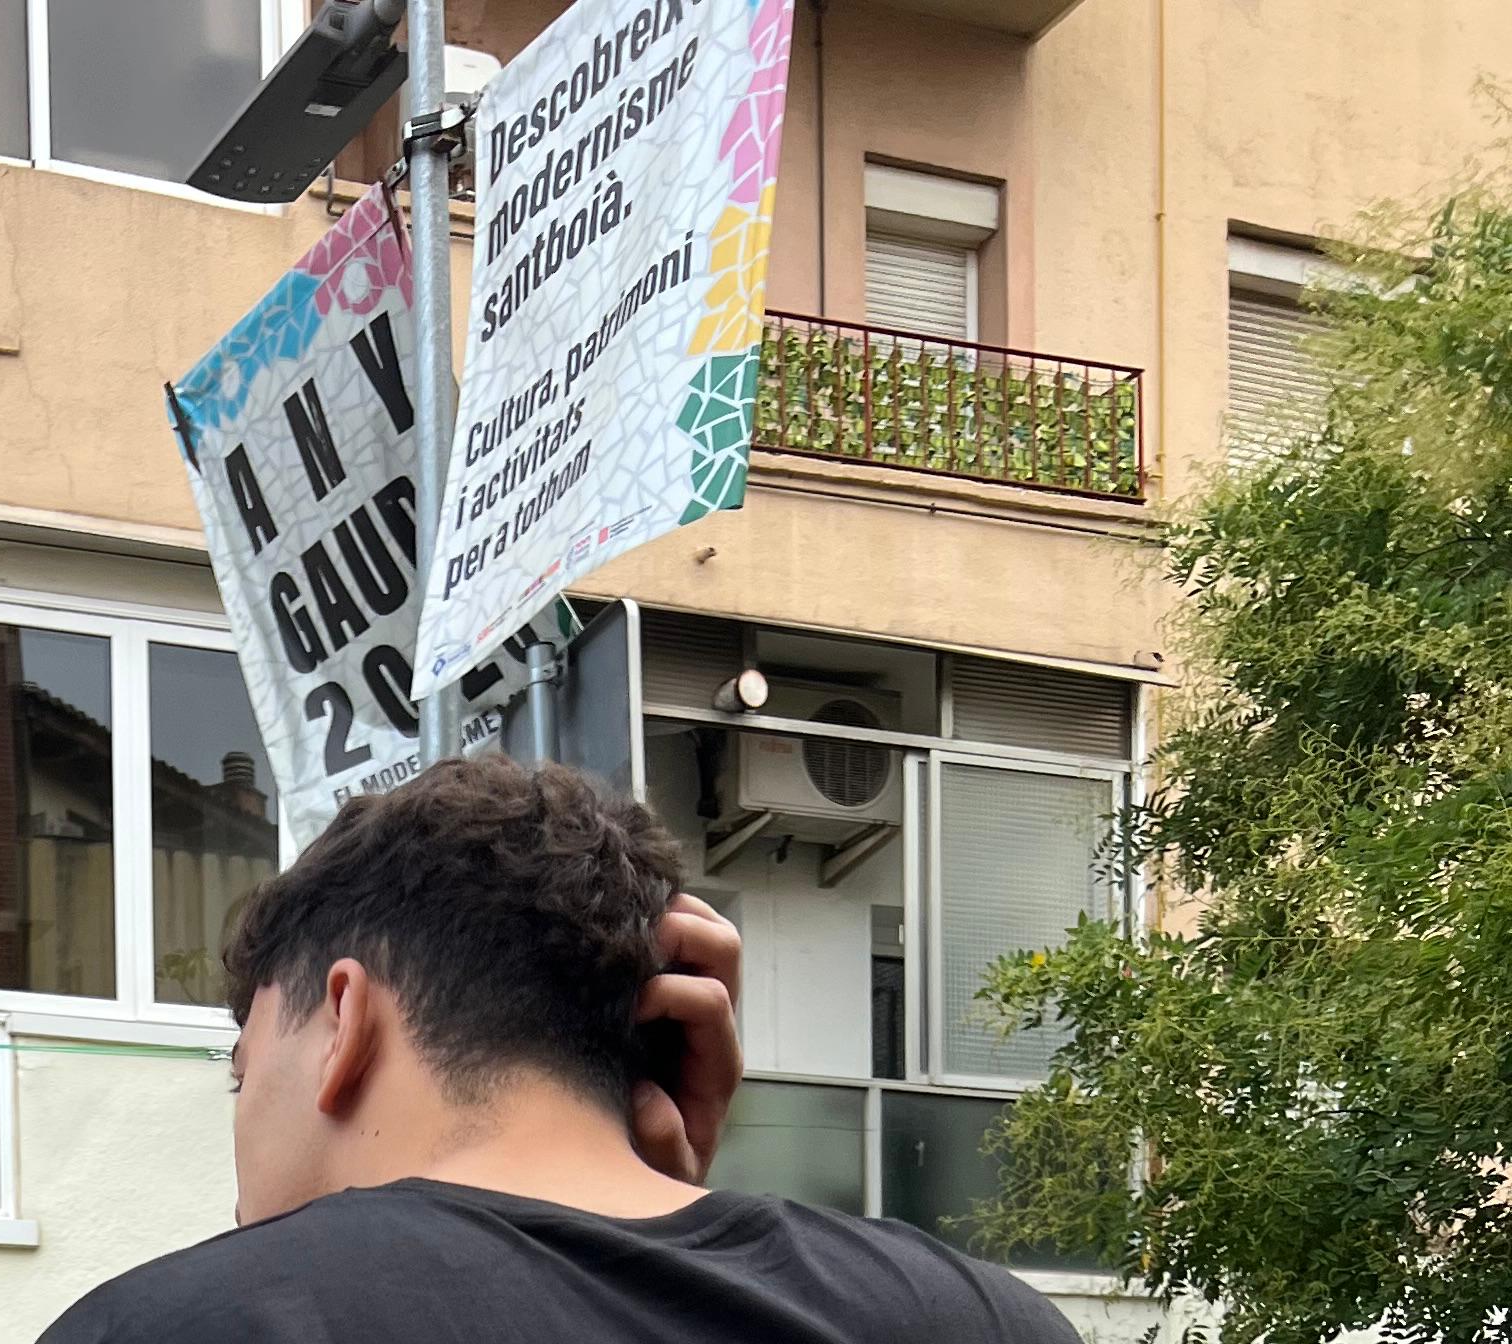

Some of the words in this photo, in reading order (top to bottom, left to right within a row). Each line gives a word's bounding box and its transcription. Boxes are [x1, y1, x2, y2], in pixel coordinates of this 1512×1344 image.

[487, 36, 699, 267] modernisme
[481, 169, 633, 343] santboià.
[465, 368, 559, 468] Cultura,
[564, 229, 694, 398] patrimoni
[443, 534, 492, 602] per
[493, 520, 510, 560] a
[512, 438, 593, 544] tothom
[455, 485, 468, 531] i
[469, 397, 585, 521] activitats
